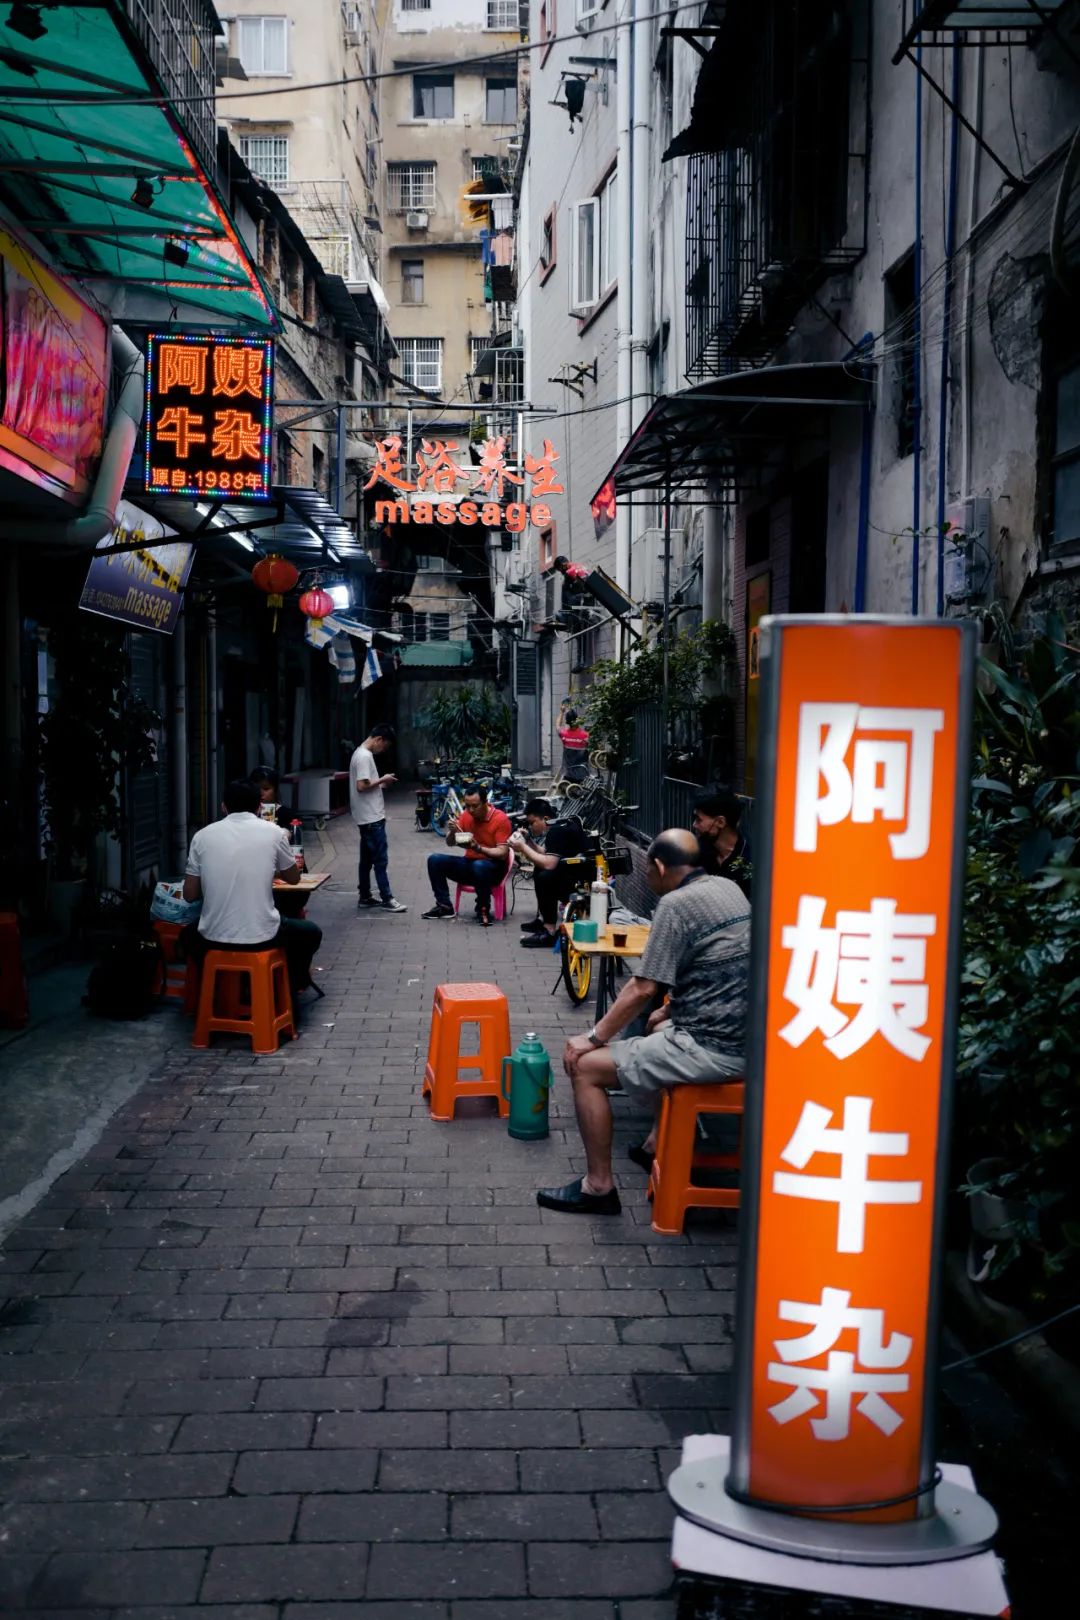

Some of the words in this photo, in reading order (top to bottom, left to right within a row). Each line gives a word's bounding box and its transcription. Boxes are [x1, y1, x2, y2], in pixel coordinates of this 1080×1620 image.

[158, 344, 264, 398] 阿姨
[156, 407, 262, 460] 牛杂
[363, 435, 564, 497] 足浴养生
[375, 499, 552, 533] massage
[124, 586, 172, 628] massage
[767, 702, 944, 1441] 阿姨牛杂
